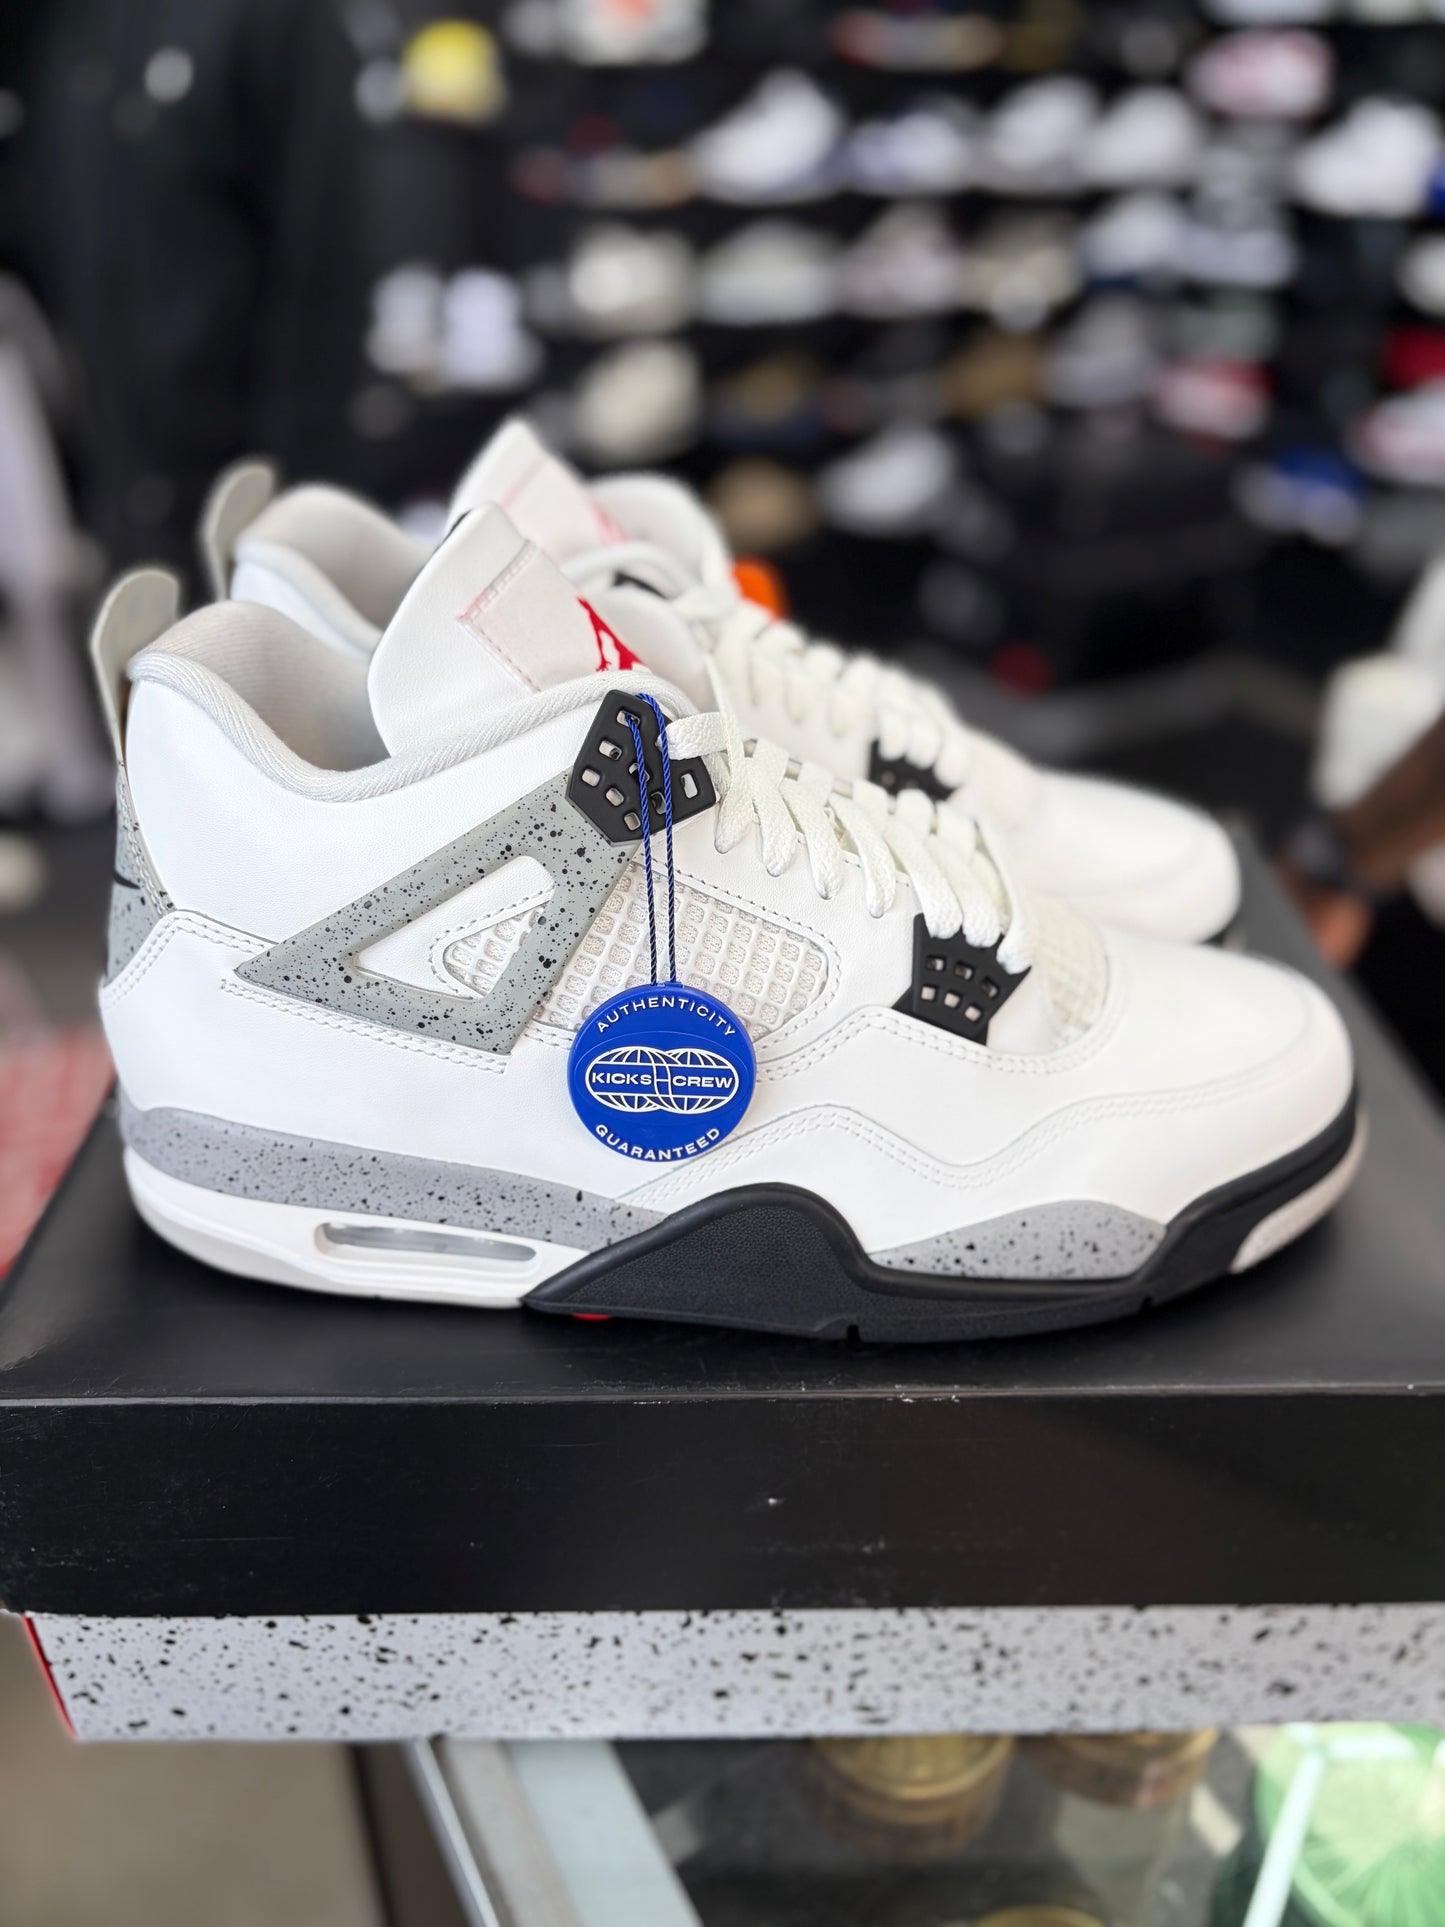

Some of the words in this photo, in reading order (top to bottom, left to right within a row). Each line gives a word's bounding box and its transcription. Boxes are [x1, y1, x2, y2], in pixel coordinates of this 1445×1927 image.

[596, 996, 736, 1037] AUTHENTICITY
[591, 1072, 652, 1085] KICKS
[672, 1075, 733, 1088] CREW
[595, 1123, 721, 1161] GUARANTEED
